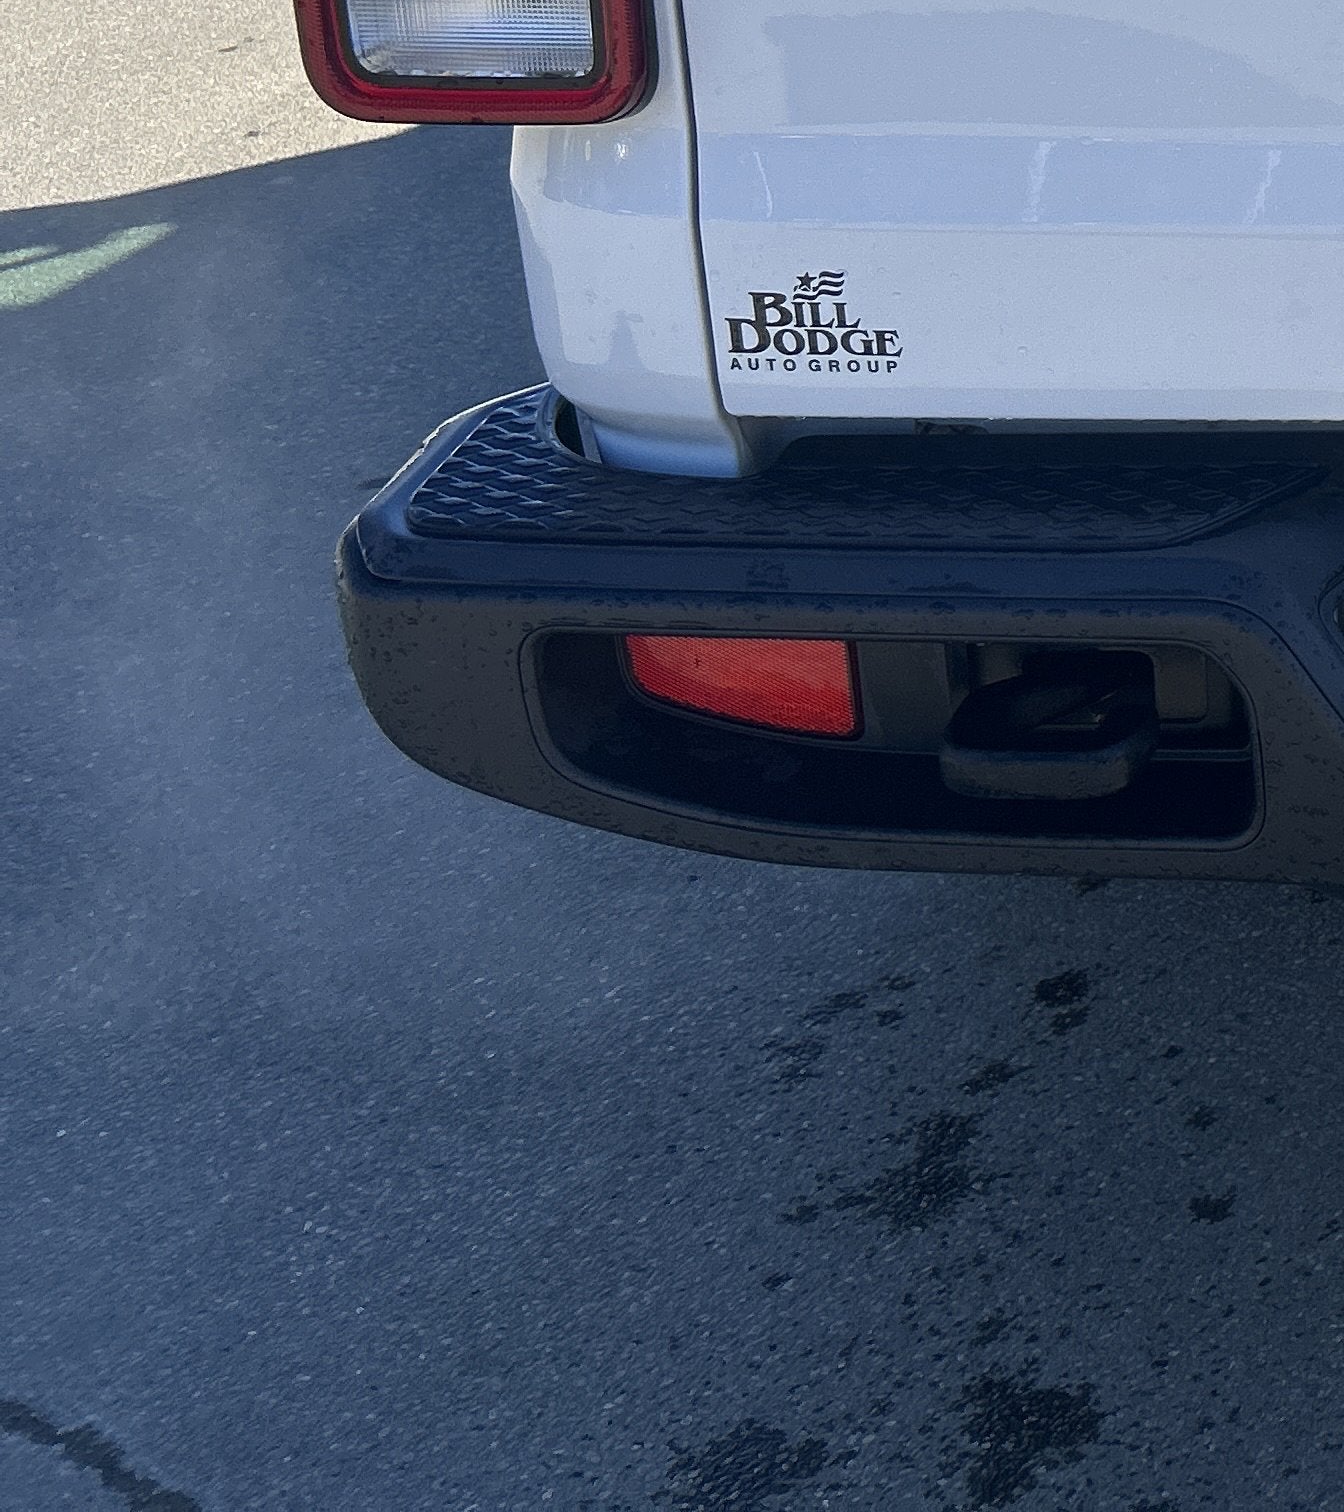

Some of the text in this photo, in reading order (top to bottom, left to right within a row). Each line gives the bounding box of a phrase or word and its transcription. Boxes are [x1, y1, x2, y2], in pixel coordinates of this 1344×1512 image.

[748, 291, 861, 329] BILL
[724, 317, 903, 358] DODGE
[730, 357, 898, 373] AUTO GROUP
